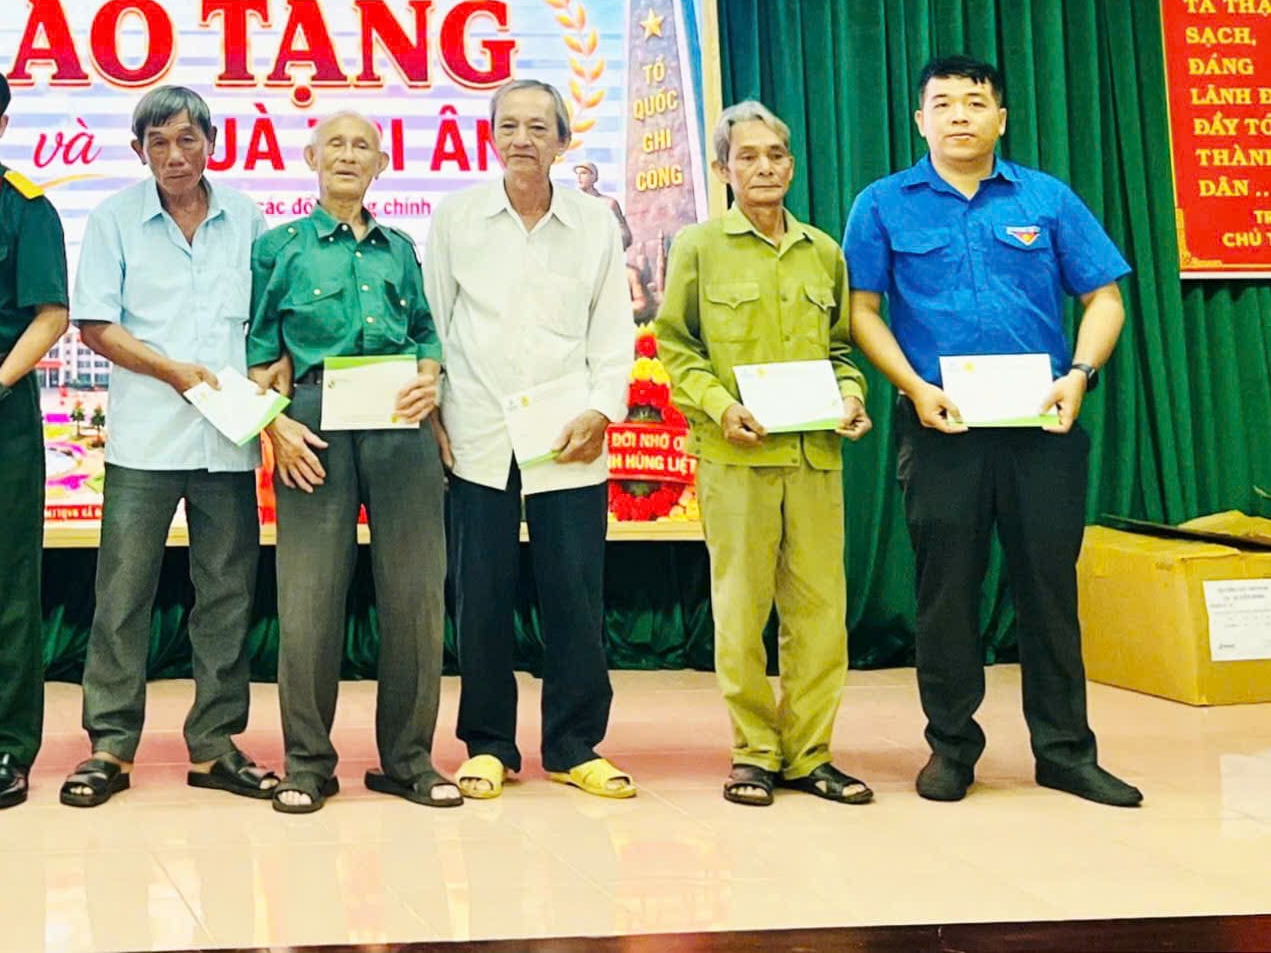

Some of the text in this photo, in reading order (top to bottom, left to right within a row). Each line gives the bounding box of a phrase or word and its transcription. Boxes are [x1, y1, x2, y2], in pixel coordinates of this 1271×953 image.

[1185, 27, 1256, 48] SẠCH,
[1188, 53, 1254, 75] ĐÁNG
[633, 85, 679, 121] QUỐC
[1190, 84, 1252, 106] LÃNH
[32, 117, 104, 169] và
[207, 102, 286, 172] UÀ
[642, 127, 673, 154] GHI
[635, 163, 684, 192] CÔNG
[1198, 176, 1249, 197] DÂN
[383, 197, 432, 215] chính
[1222, 227, 1263, 247] CHỦ
[625, 450, 665, 471] HÙNG
[667, 455, 697, 475] LIỆT
